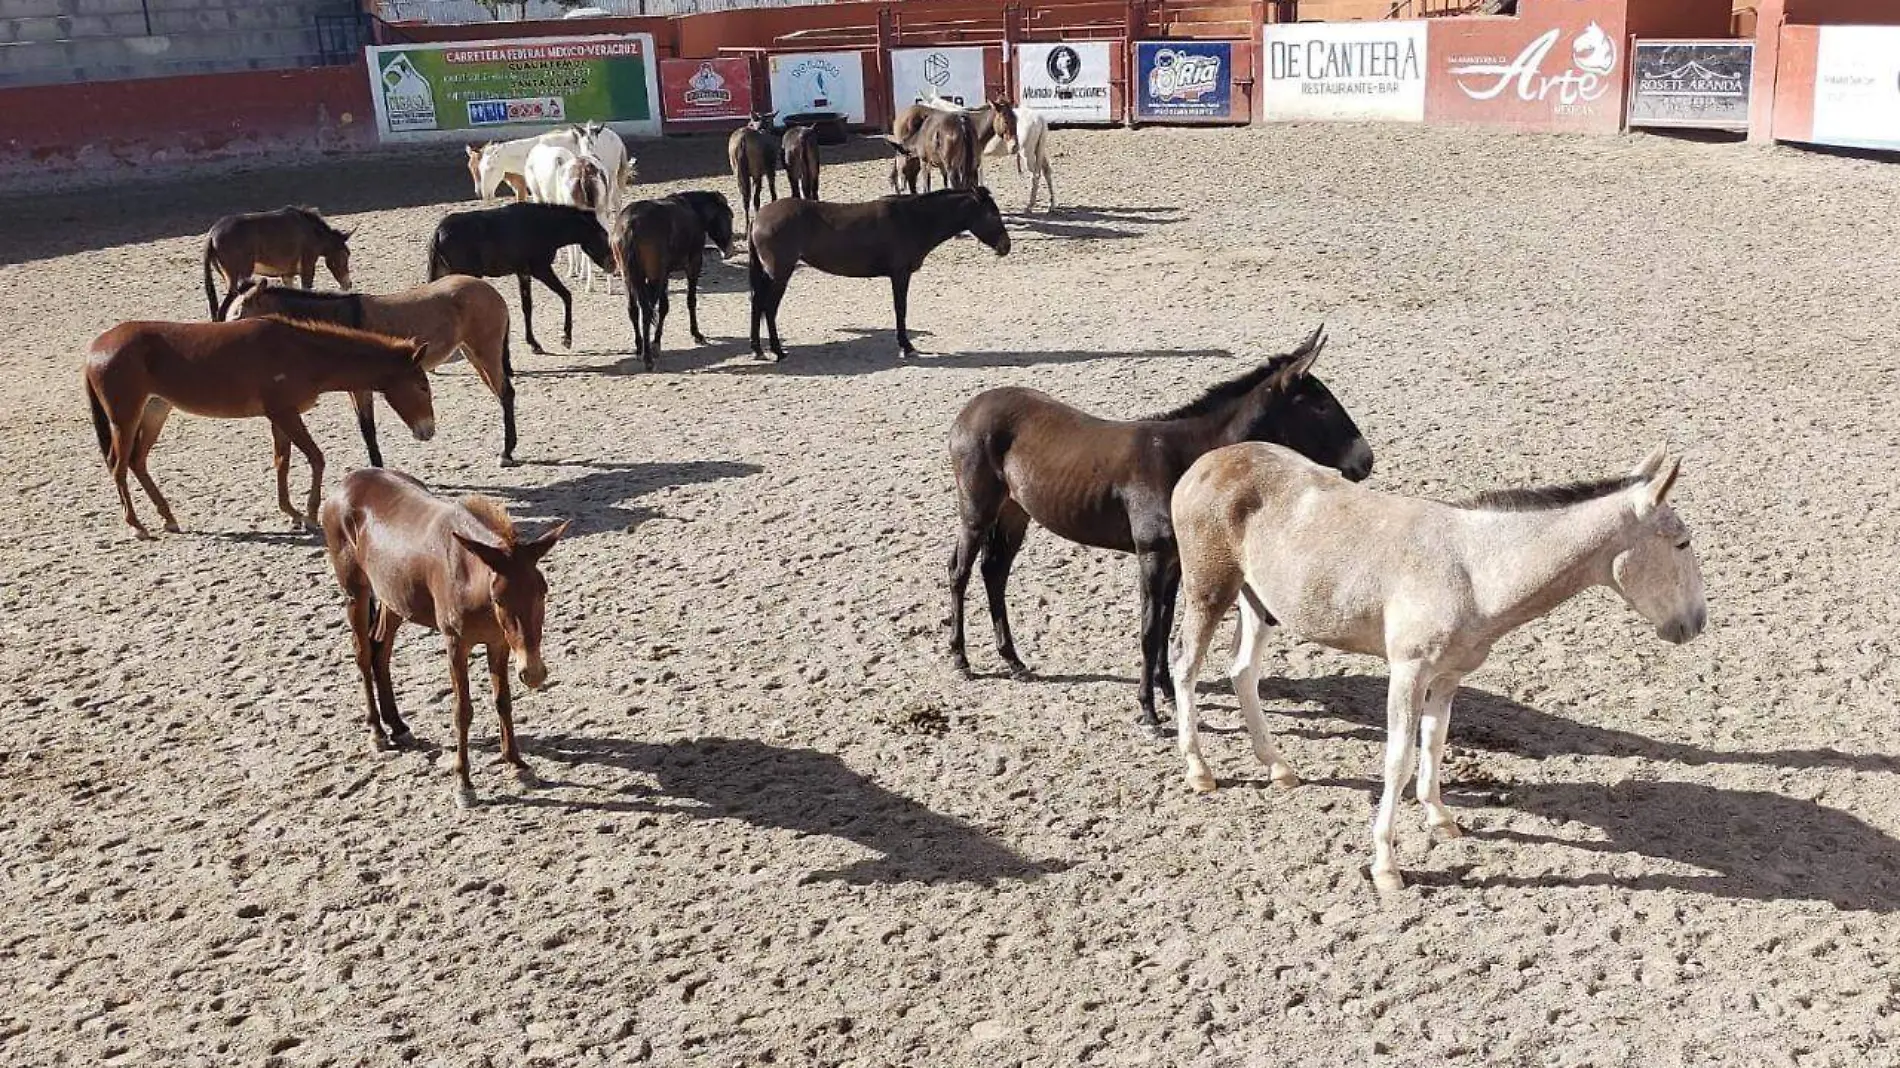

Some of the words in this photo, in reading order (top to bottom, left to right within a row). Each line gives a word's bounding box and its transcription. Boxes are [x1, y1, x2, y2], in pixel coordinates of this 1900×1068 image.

[446, 49, 506, 63] CARRETERA
[507, 46, 546, 61] FEDERAL
[1270, 41, 1302, 80] DE
[1306, 37, 1420, 80] CANTERA
[1449, 28, 1609, 104] Arte
[1301, 82, 1399, 95] RESTAURANTE-BAR
[1639, 79, 1686, 91] ROSETE
[1690, 78, 1743, 91] ARANDA
